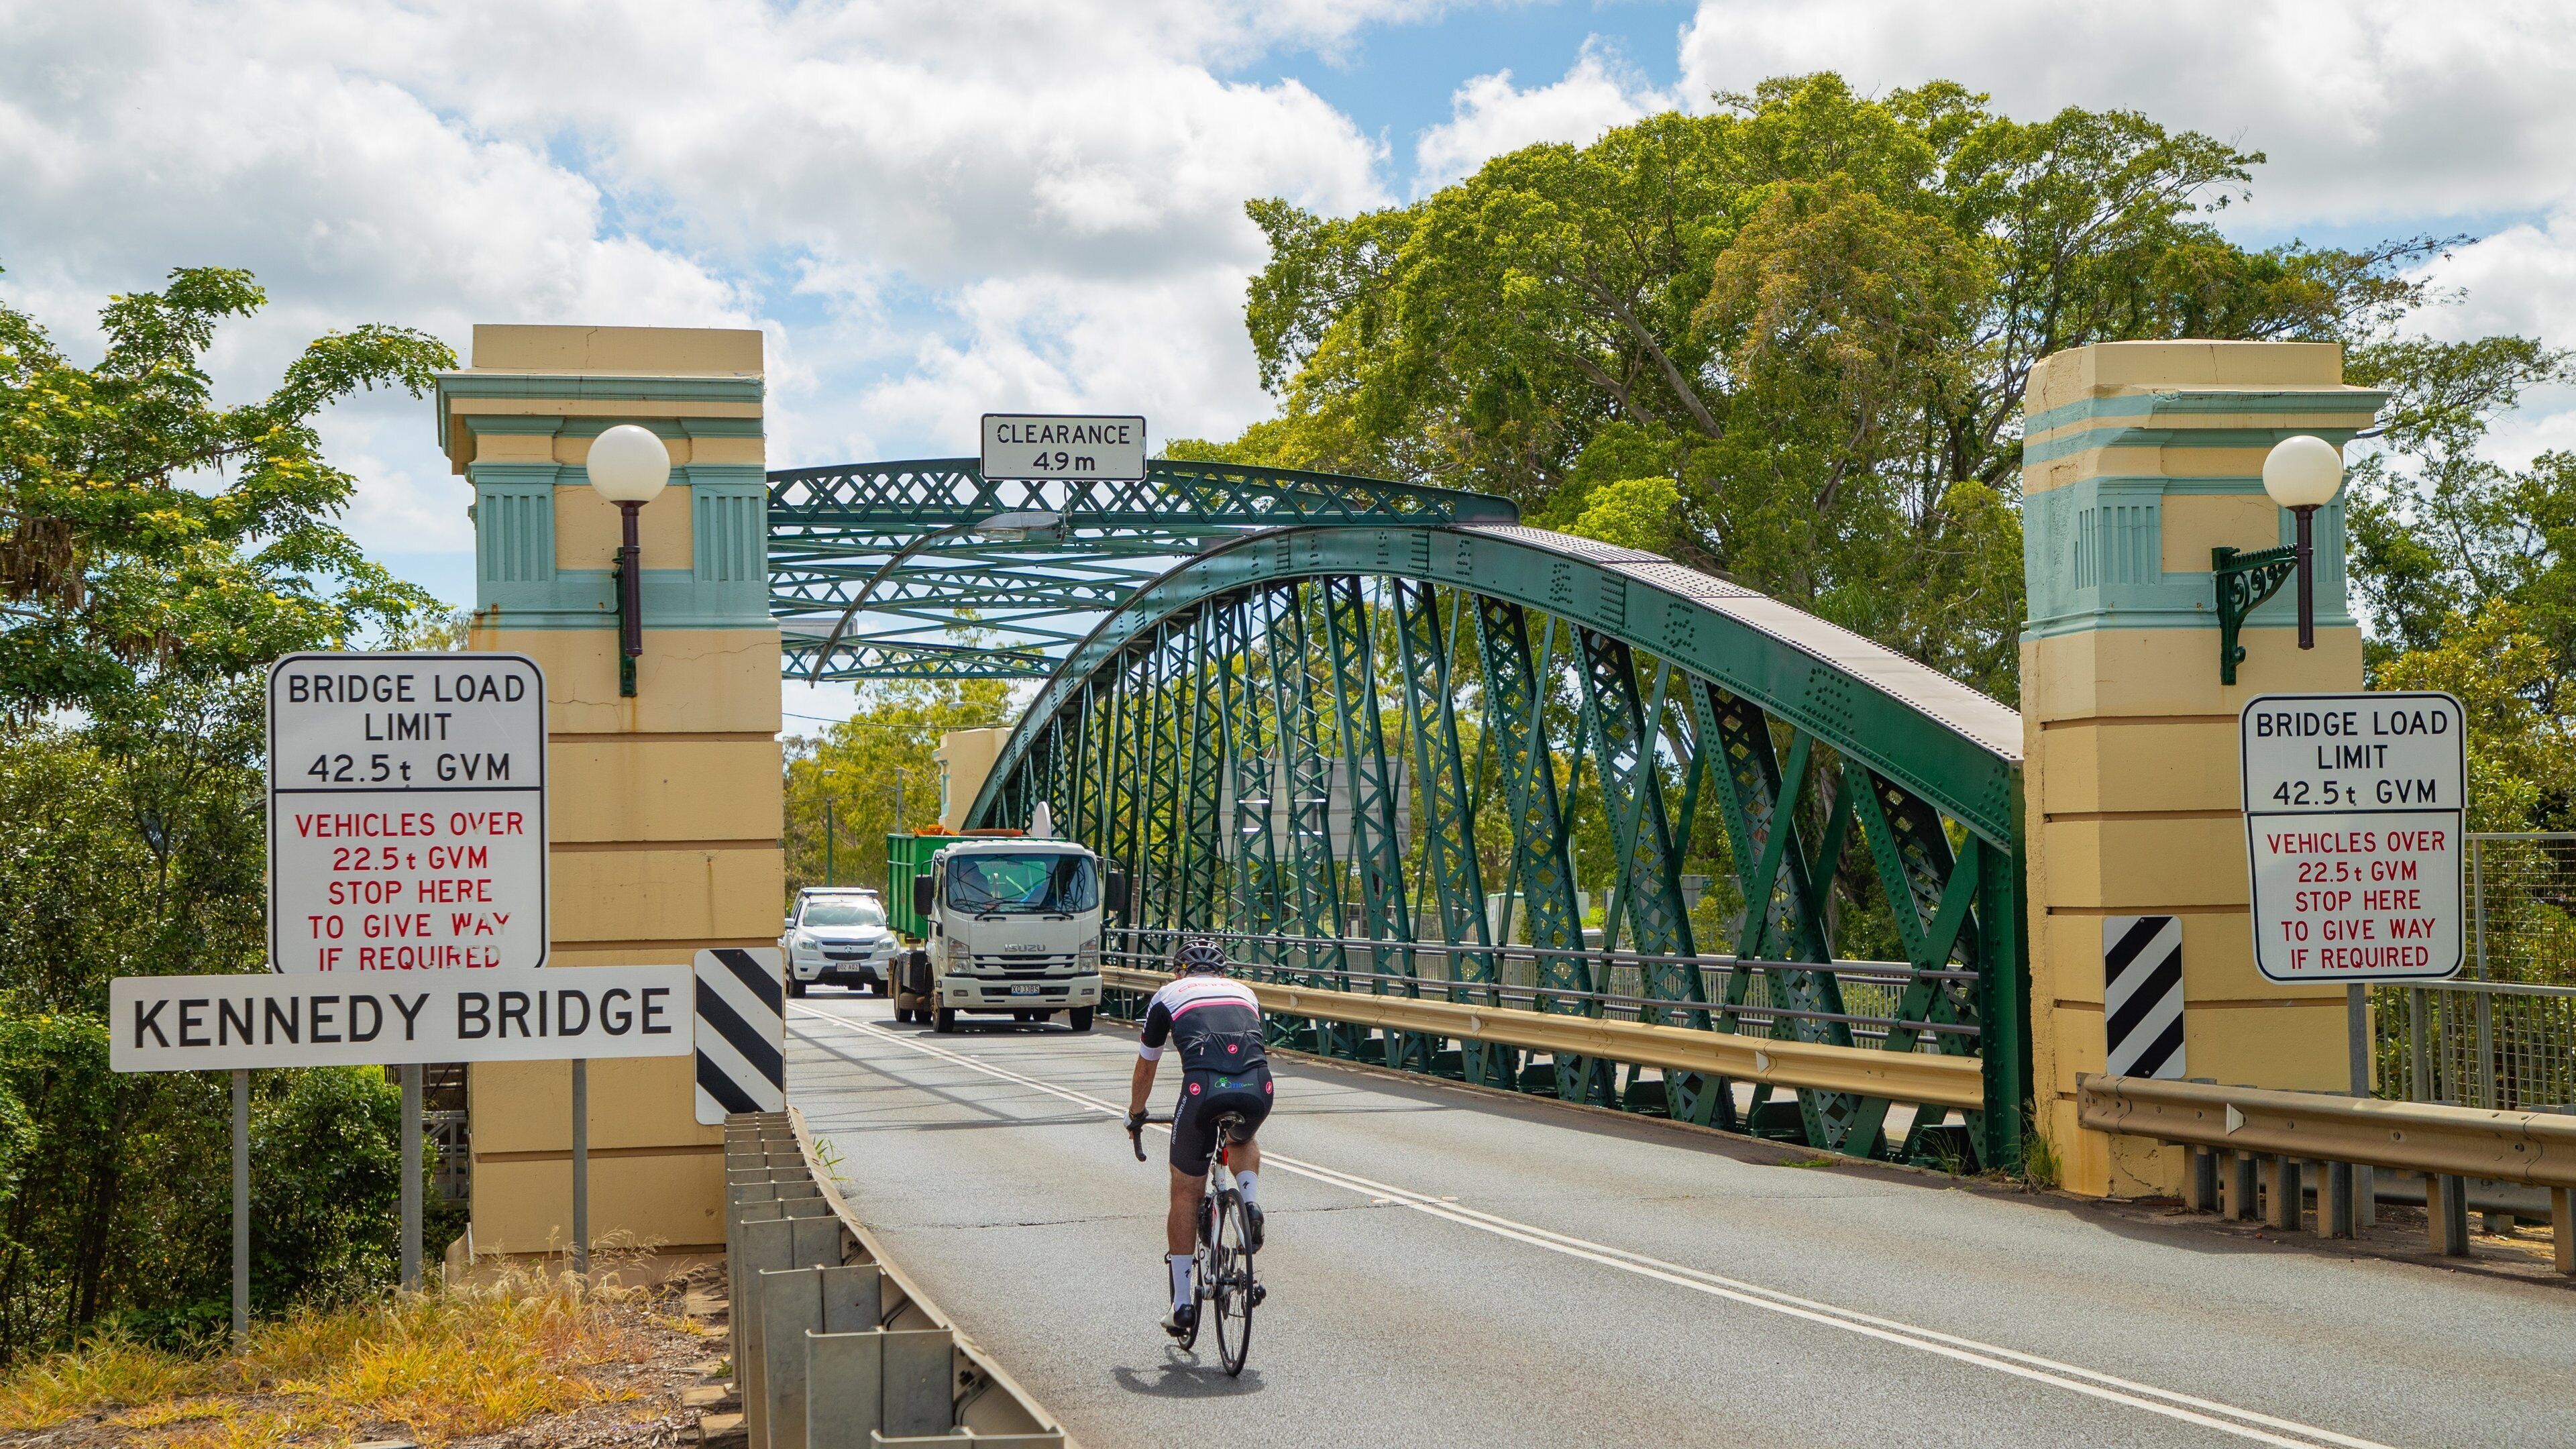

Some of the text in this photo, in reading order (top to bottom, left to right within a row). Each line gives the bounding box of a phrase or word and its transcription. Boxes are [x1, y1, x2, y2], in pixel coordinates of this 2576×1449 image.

[998, 424, 1130, 445] CLEARANCE
[289, 675, 525, 703] BRIDGE LOAD
[366, 713, 452, 741] LIMIT
[2257, 711, 2448, 737] BRIDGE LOAD
[437, 753, 509, 782] GVM
[2318, 745, 2388, 769] LIMIT
[2377, 780, 2436, 804] GVM
[295, 812, 524, 837] VEHICLES OVER
[2267, 831, 2445, 854] VEHICLES OVER
[429, 846, 488, 869] GVM
[2371, 861, 2417, 881] GVM
[329, 878, 494, 905] STOP HERE
[2296, 890, 2420, 912] STOP HERE
[308, 912, 511, 939] TO GIVE WAY
[2281, 918, 2436, 941] TO GIVE WAY
[319, 945, 501, 972] IF REQUIRED
[1004, 944, 1046, 952] ISUZU
[2291, 946, 2428, 969] IF REQUIRED
[136, 988, 672, 1049] KENNEDY BRIDGE
